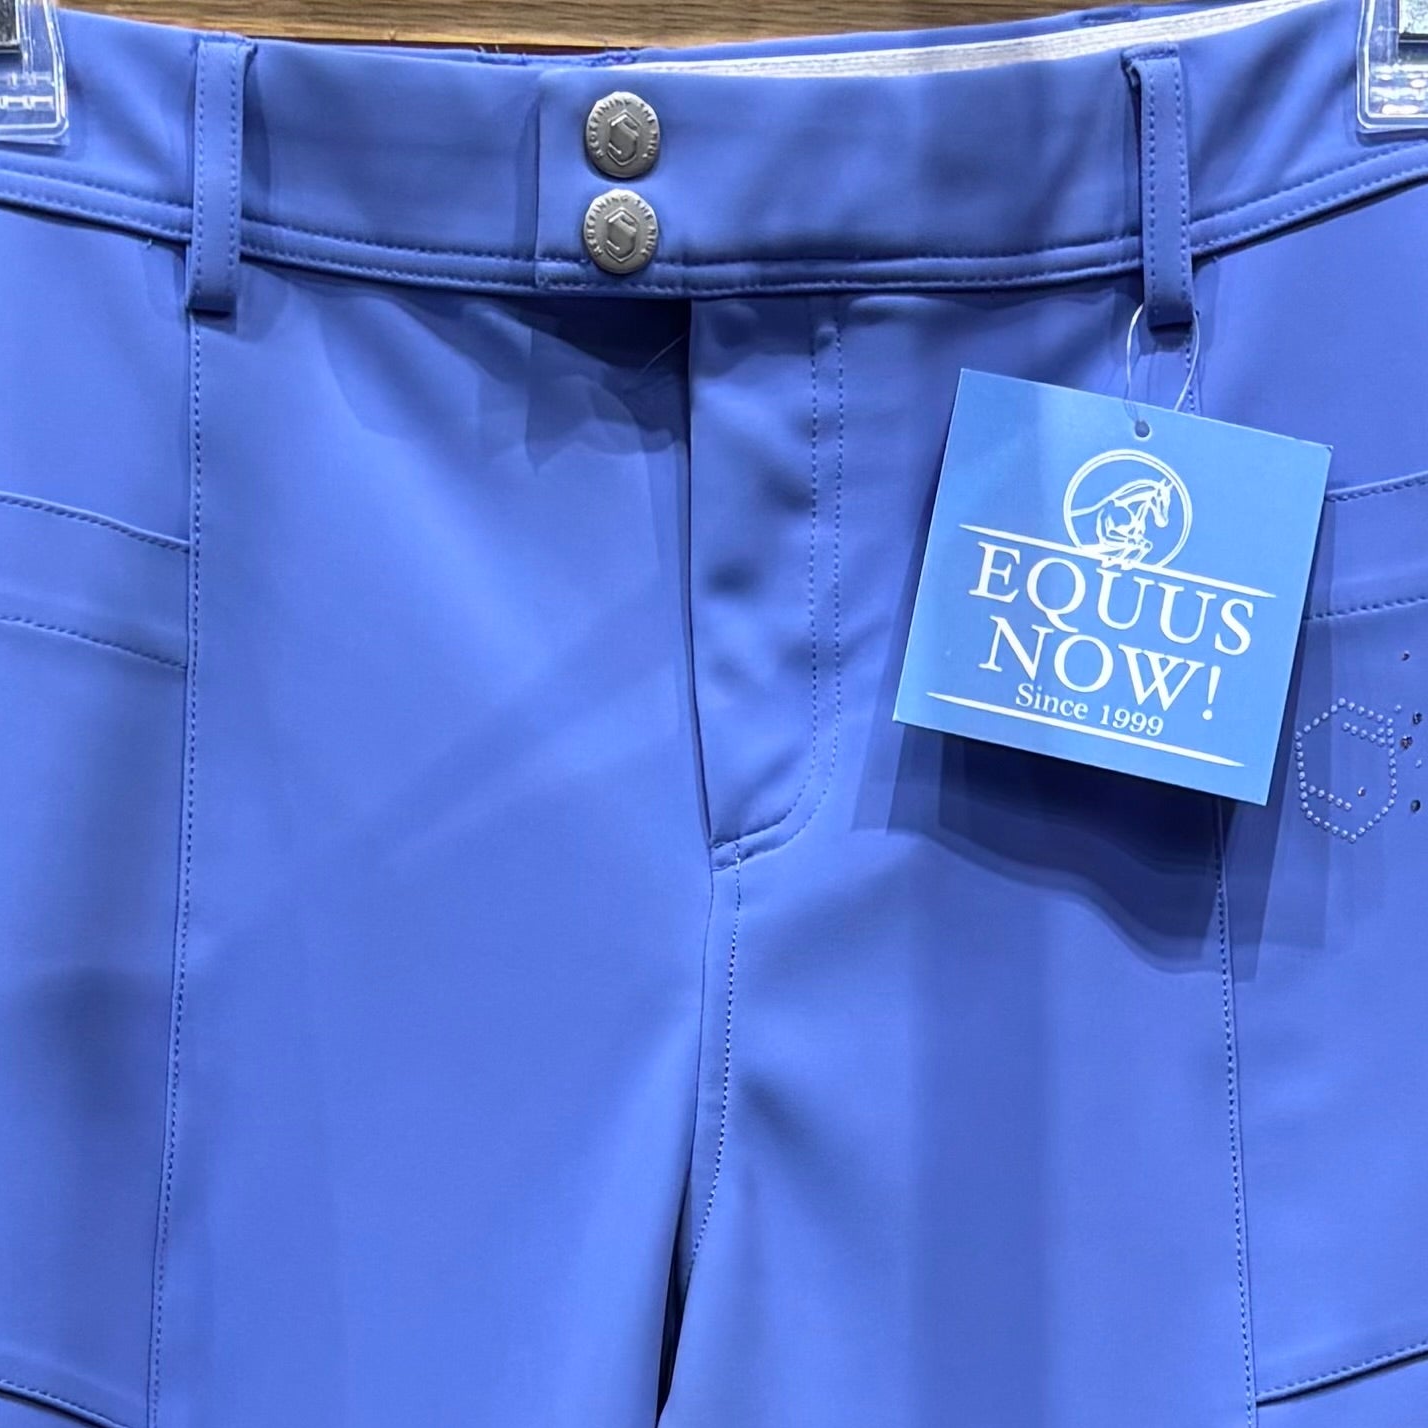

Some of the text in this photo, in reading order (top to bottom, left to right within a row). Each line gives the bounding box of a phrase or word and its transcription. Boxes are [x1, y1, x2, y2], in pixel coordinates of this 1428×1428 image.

[968, 541, 1254, 656] EQUUS
[978, 615, 1222, 721] NOW!
[1015, 682, 1164, 737] Since 1999
